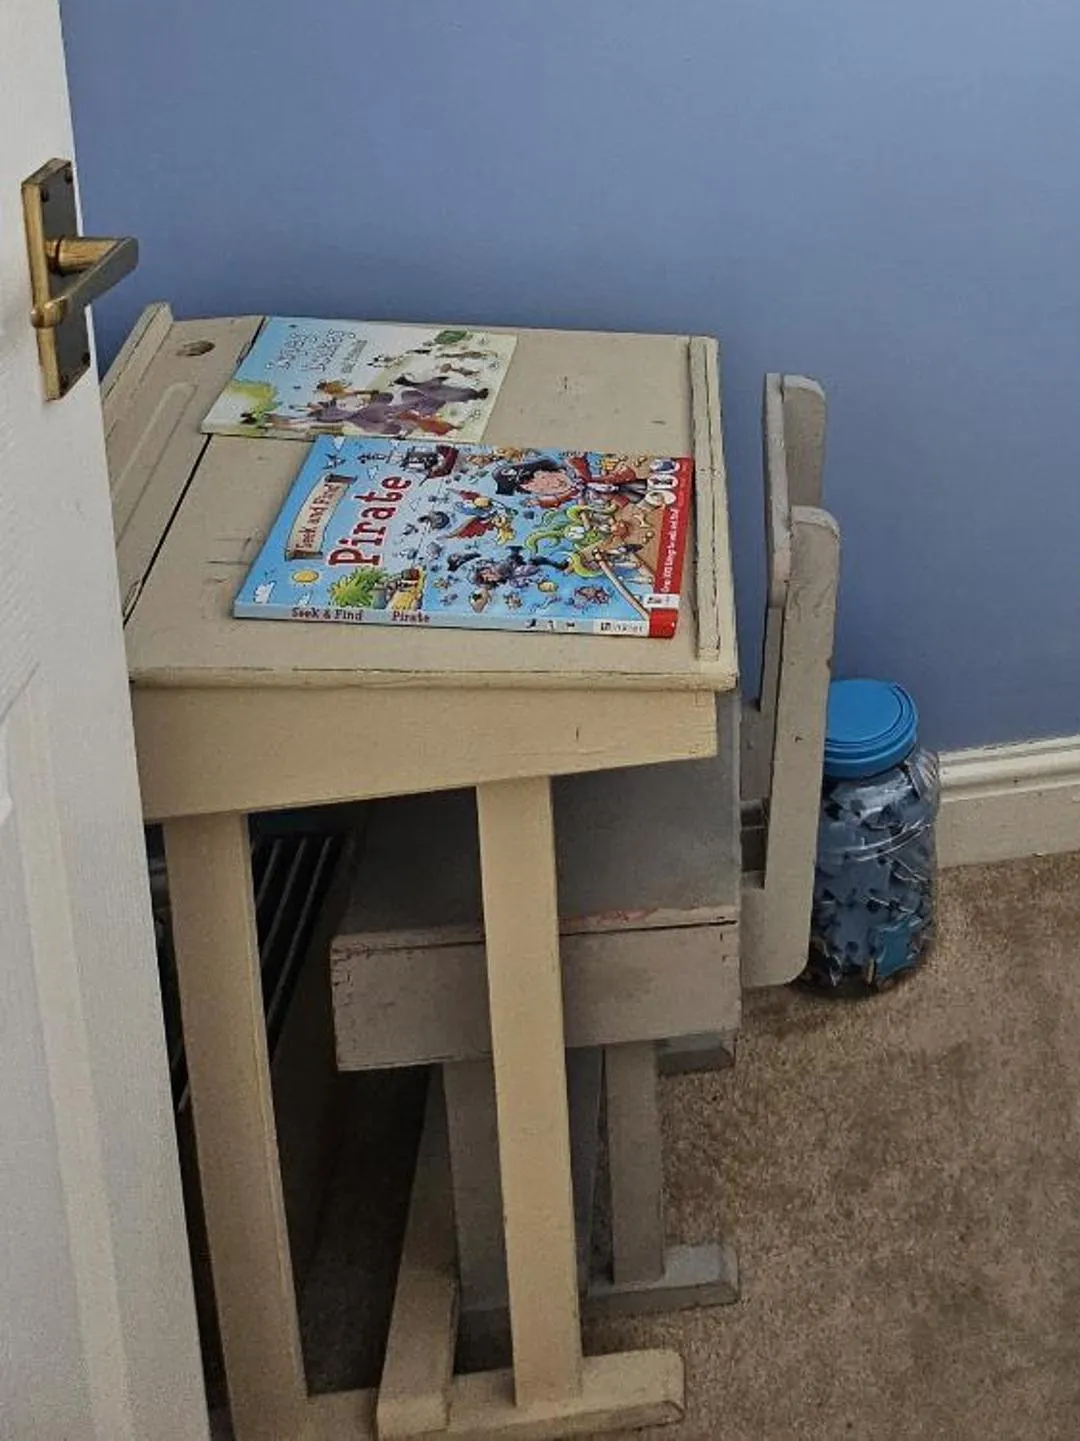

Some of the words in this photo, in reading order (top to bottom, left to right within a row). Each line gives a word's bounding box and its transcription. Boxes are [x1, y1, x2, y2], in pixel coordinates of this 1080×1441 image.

[328, 476, 412, 565] Pirate
[291, 607, 319, 618] Seek
[334, 609, 363, 621] Find
[392, 611, 430, 623] Pirate
